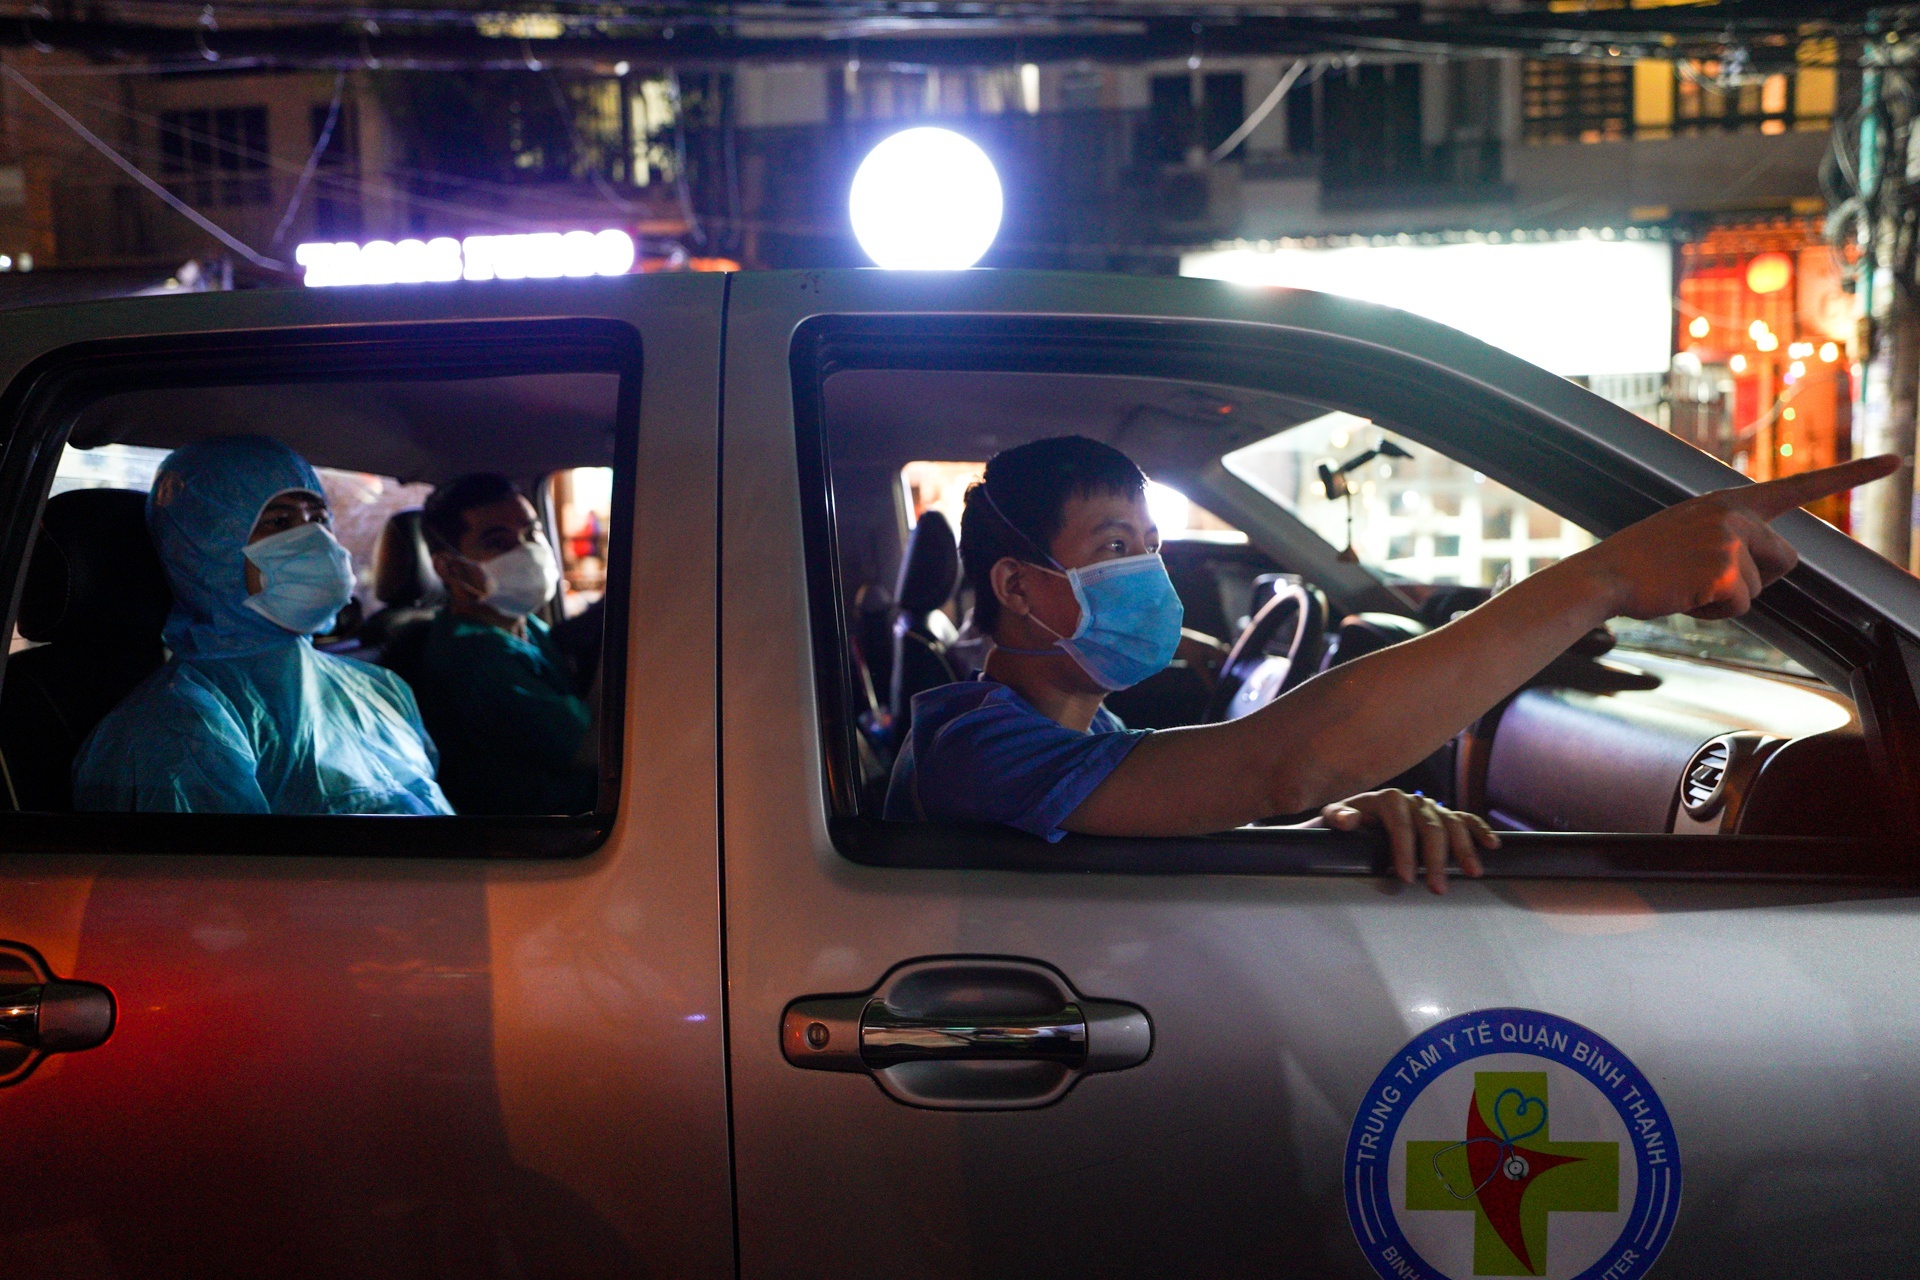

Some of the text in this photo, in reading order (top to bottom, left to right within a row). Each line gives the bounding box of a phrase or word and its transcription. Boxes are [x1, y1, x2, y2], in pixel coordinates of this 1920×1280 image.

[1357, 1020, 1667, 1165] TRUNG TÂM Y TẾ QUẬN BÌNH THẠNH
